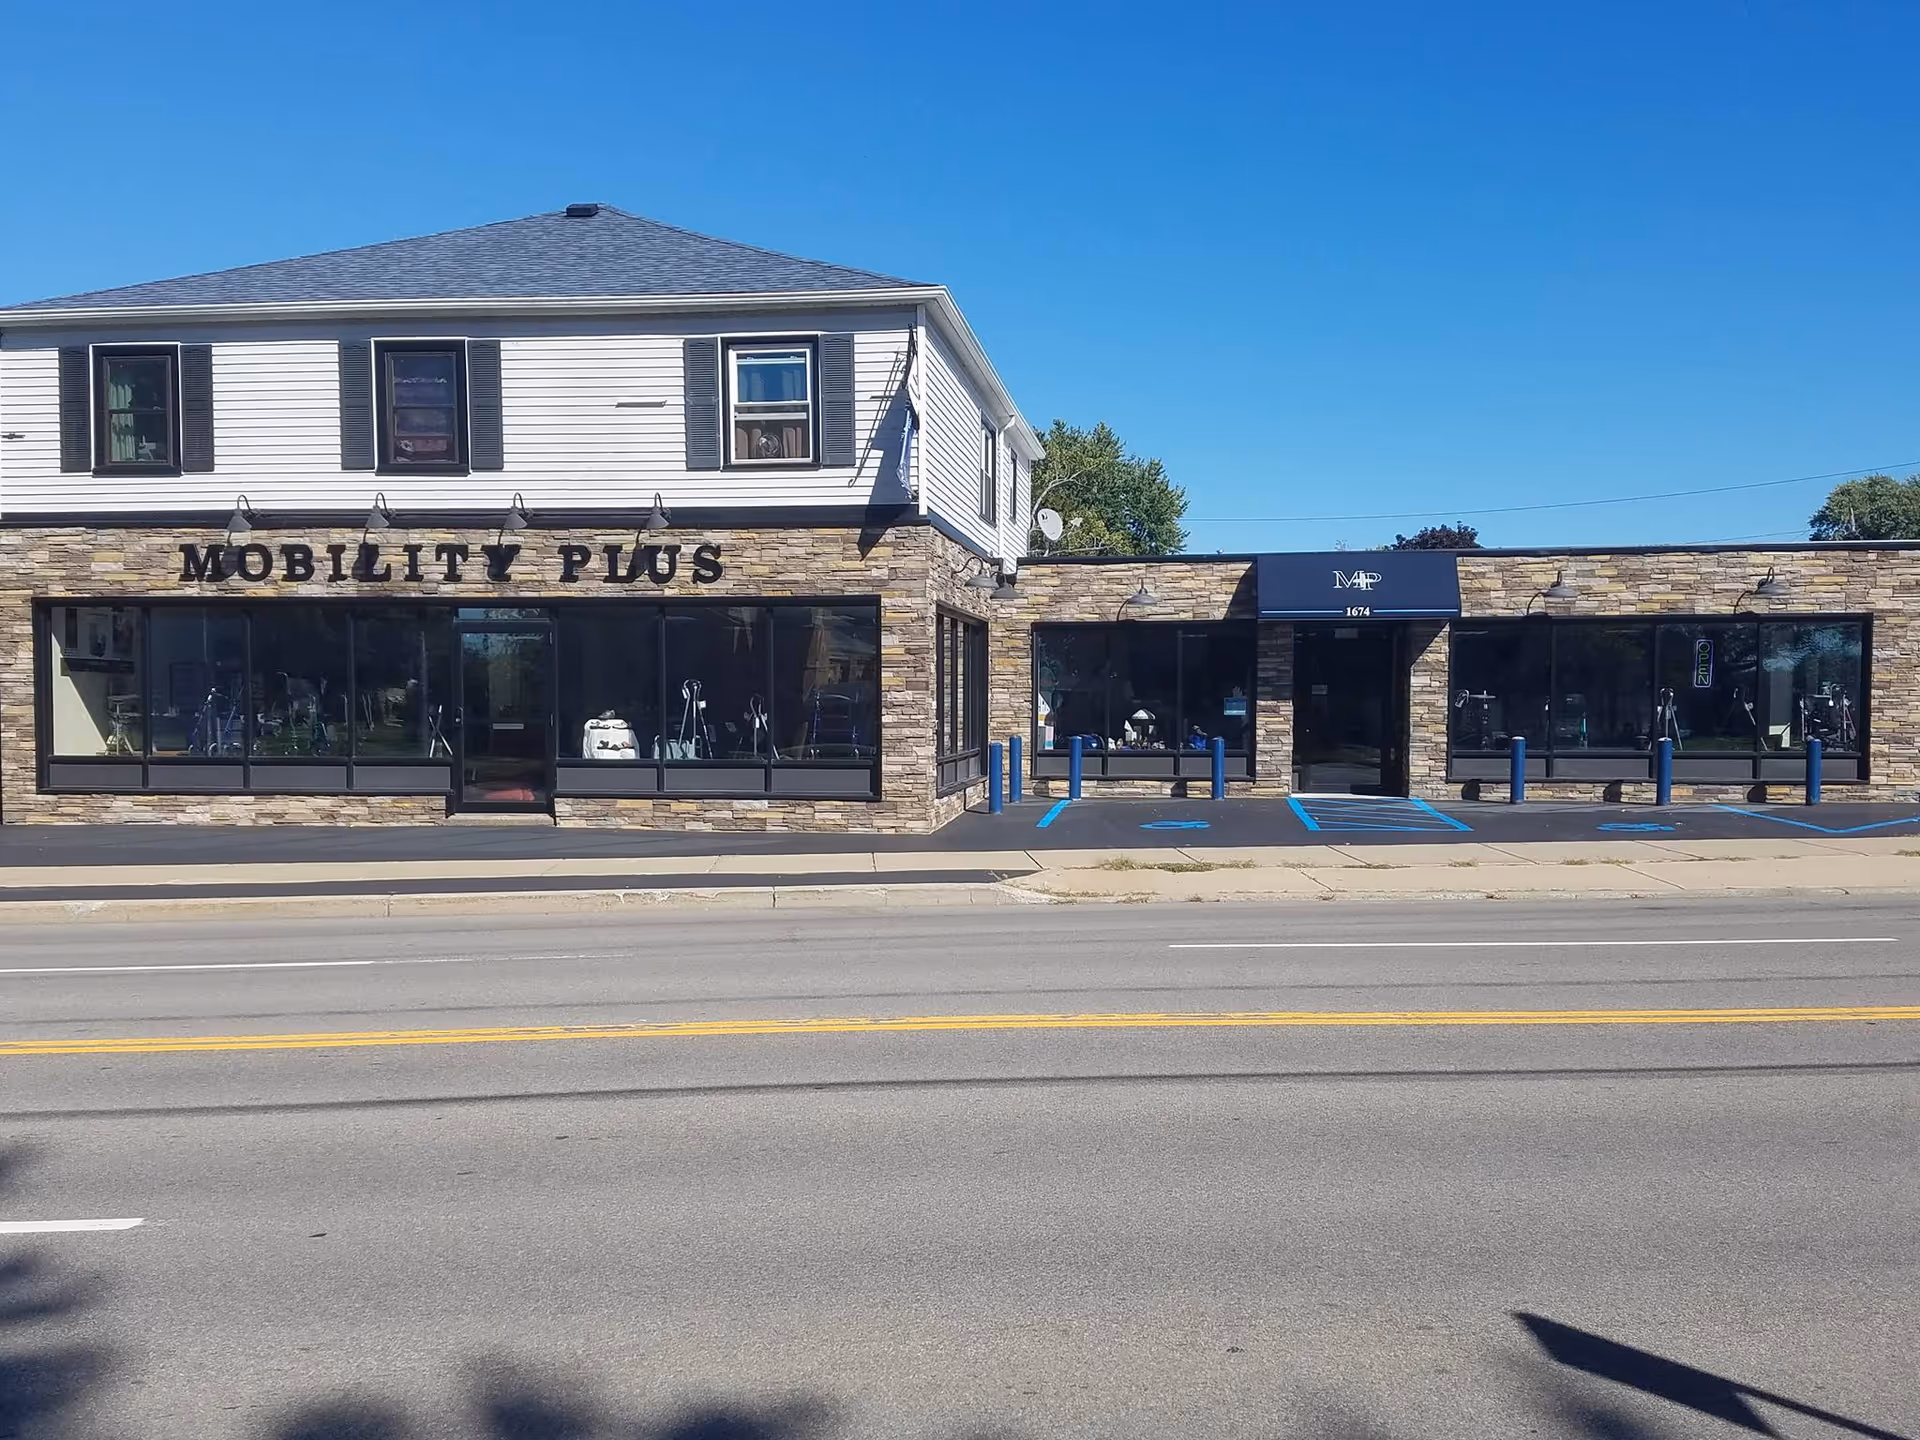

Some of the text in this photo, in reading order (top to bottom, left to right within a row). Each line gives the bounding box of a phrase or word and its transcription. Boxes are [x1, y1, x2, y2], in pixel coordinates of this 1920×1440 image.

[178, 543, 723, 584] MOBILITY PLUS
[1346, 606, 1370, 616] 1674
[1698, 642, 1710, 685] OPEN
